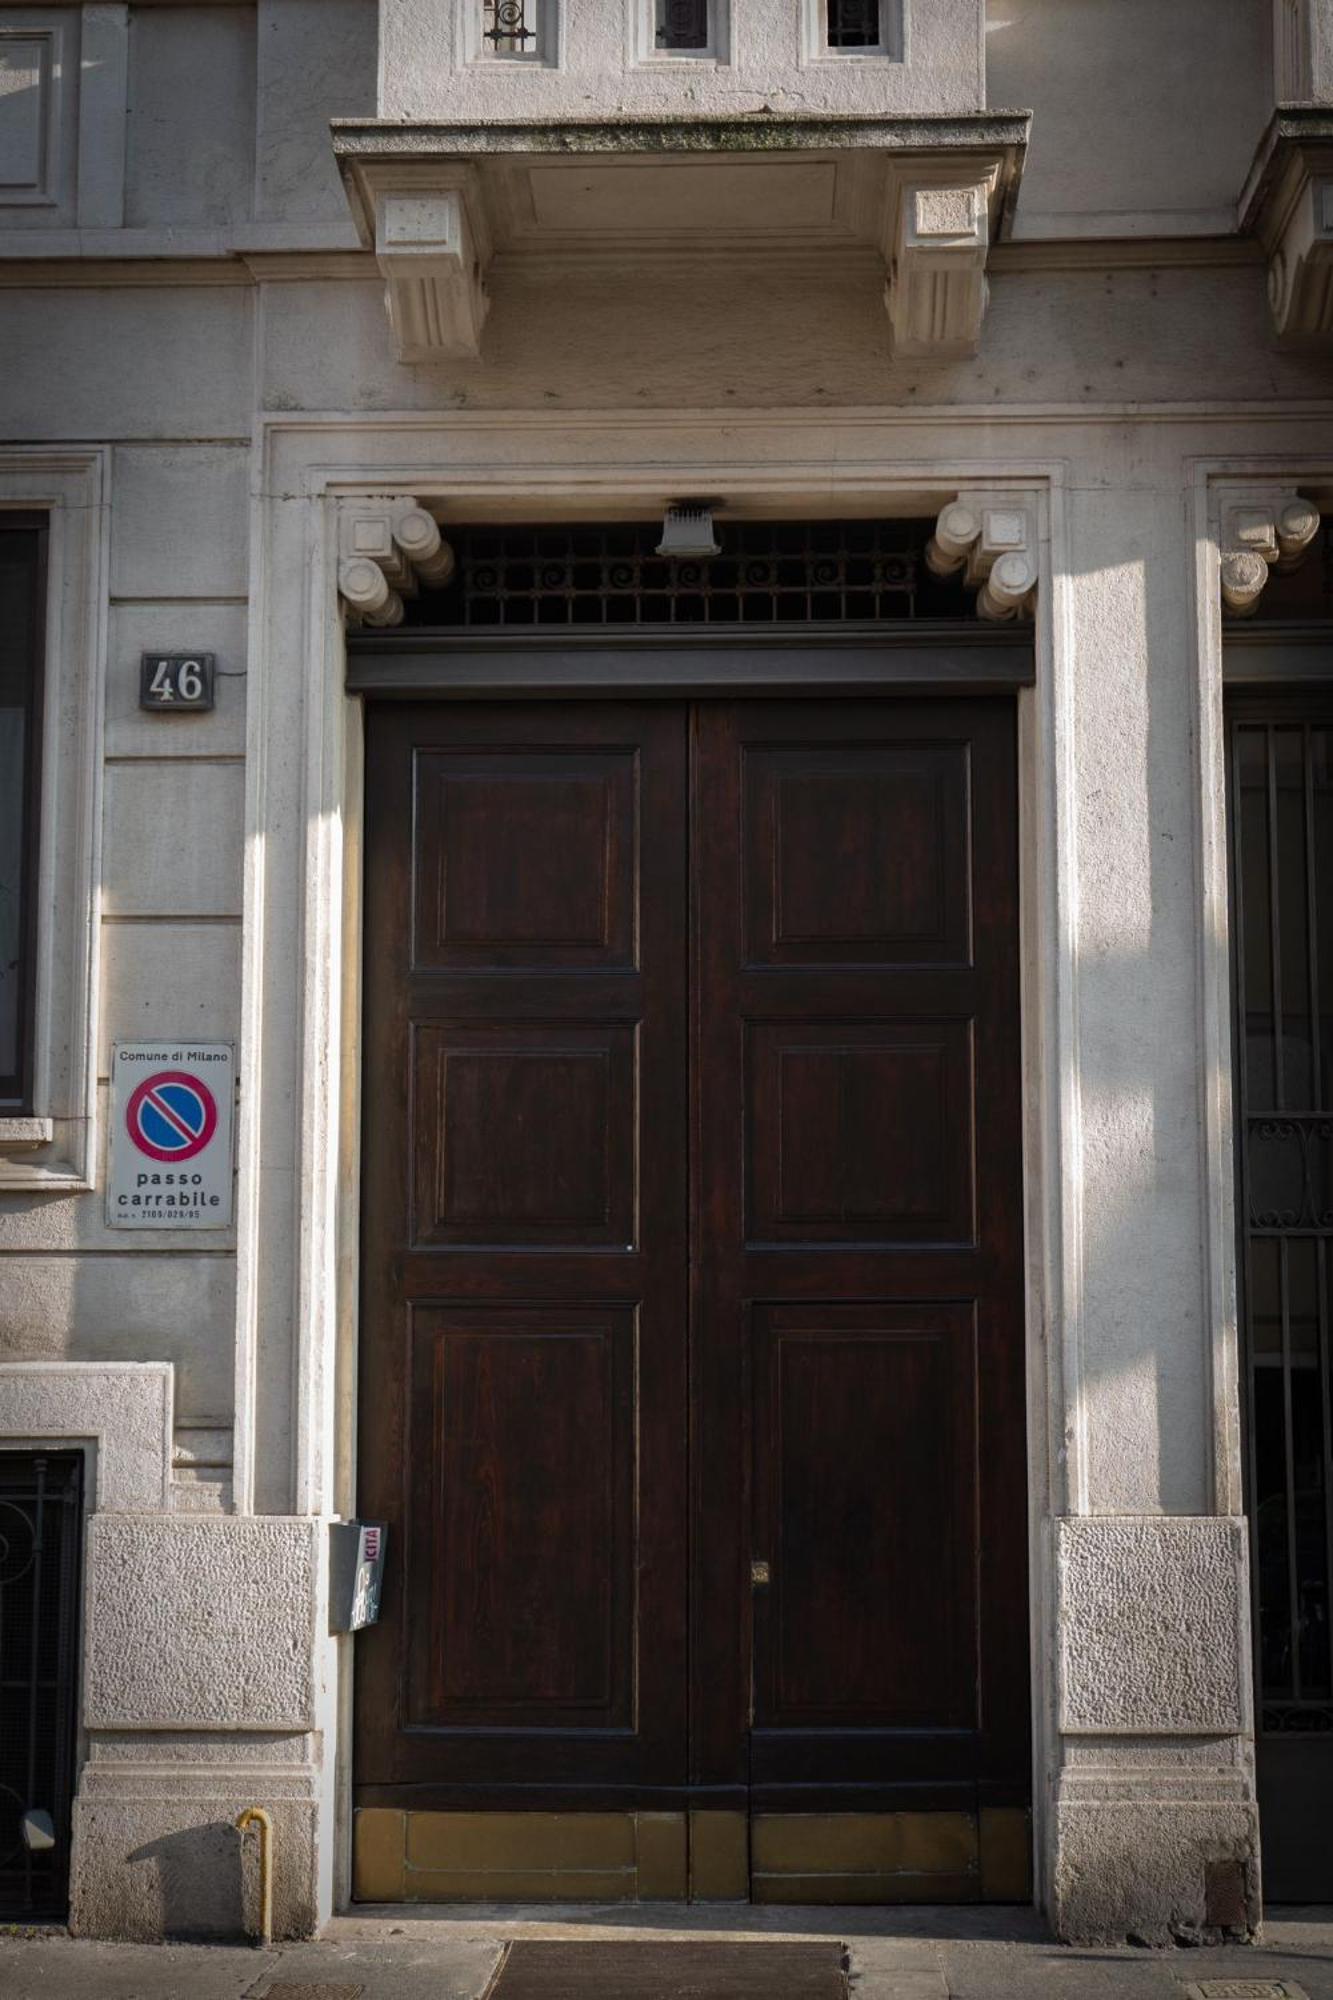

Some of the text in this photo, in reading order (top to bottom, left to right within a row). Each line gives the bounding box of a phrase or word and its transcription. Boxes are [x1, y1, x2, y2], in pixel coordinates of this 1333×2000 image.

[149, 661, 202, 701] 46
[120, 1051, 228, 1061] Comune di Milano
[137, 1173, 202, 1187] passo
[118, 1191, 220, 1206] carrabile
